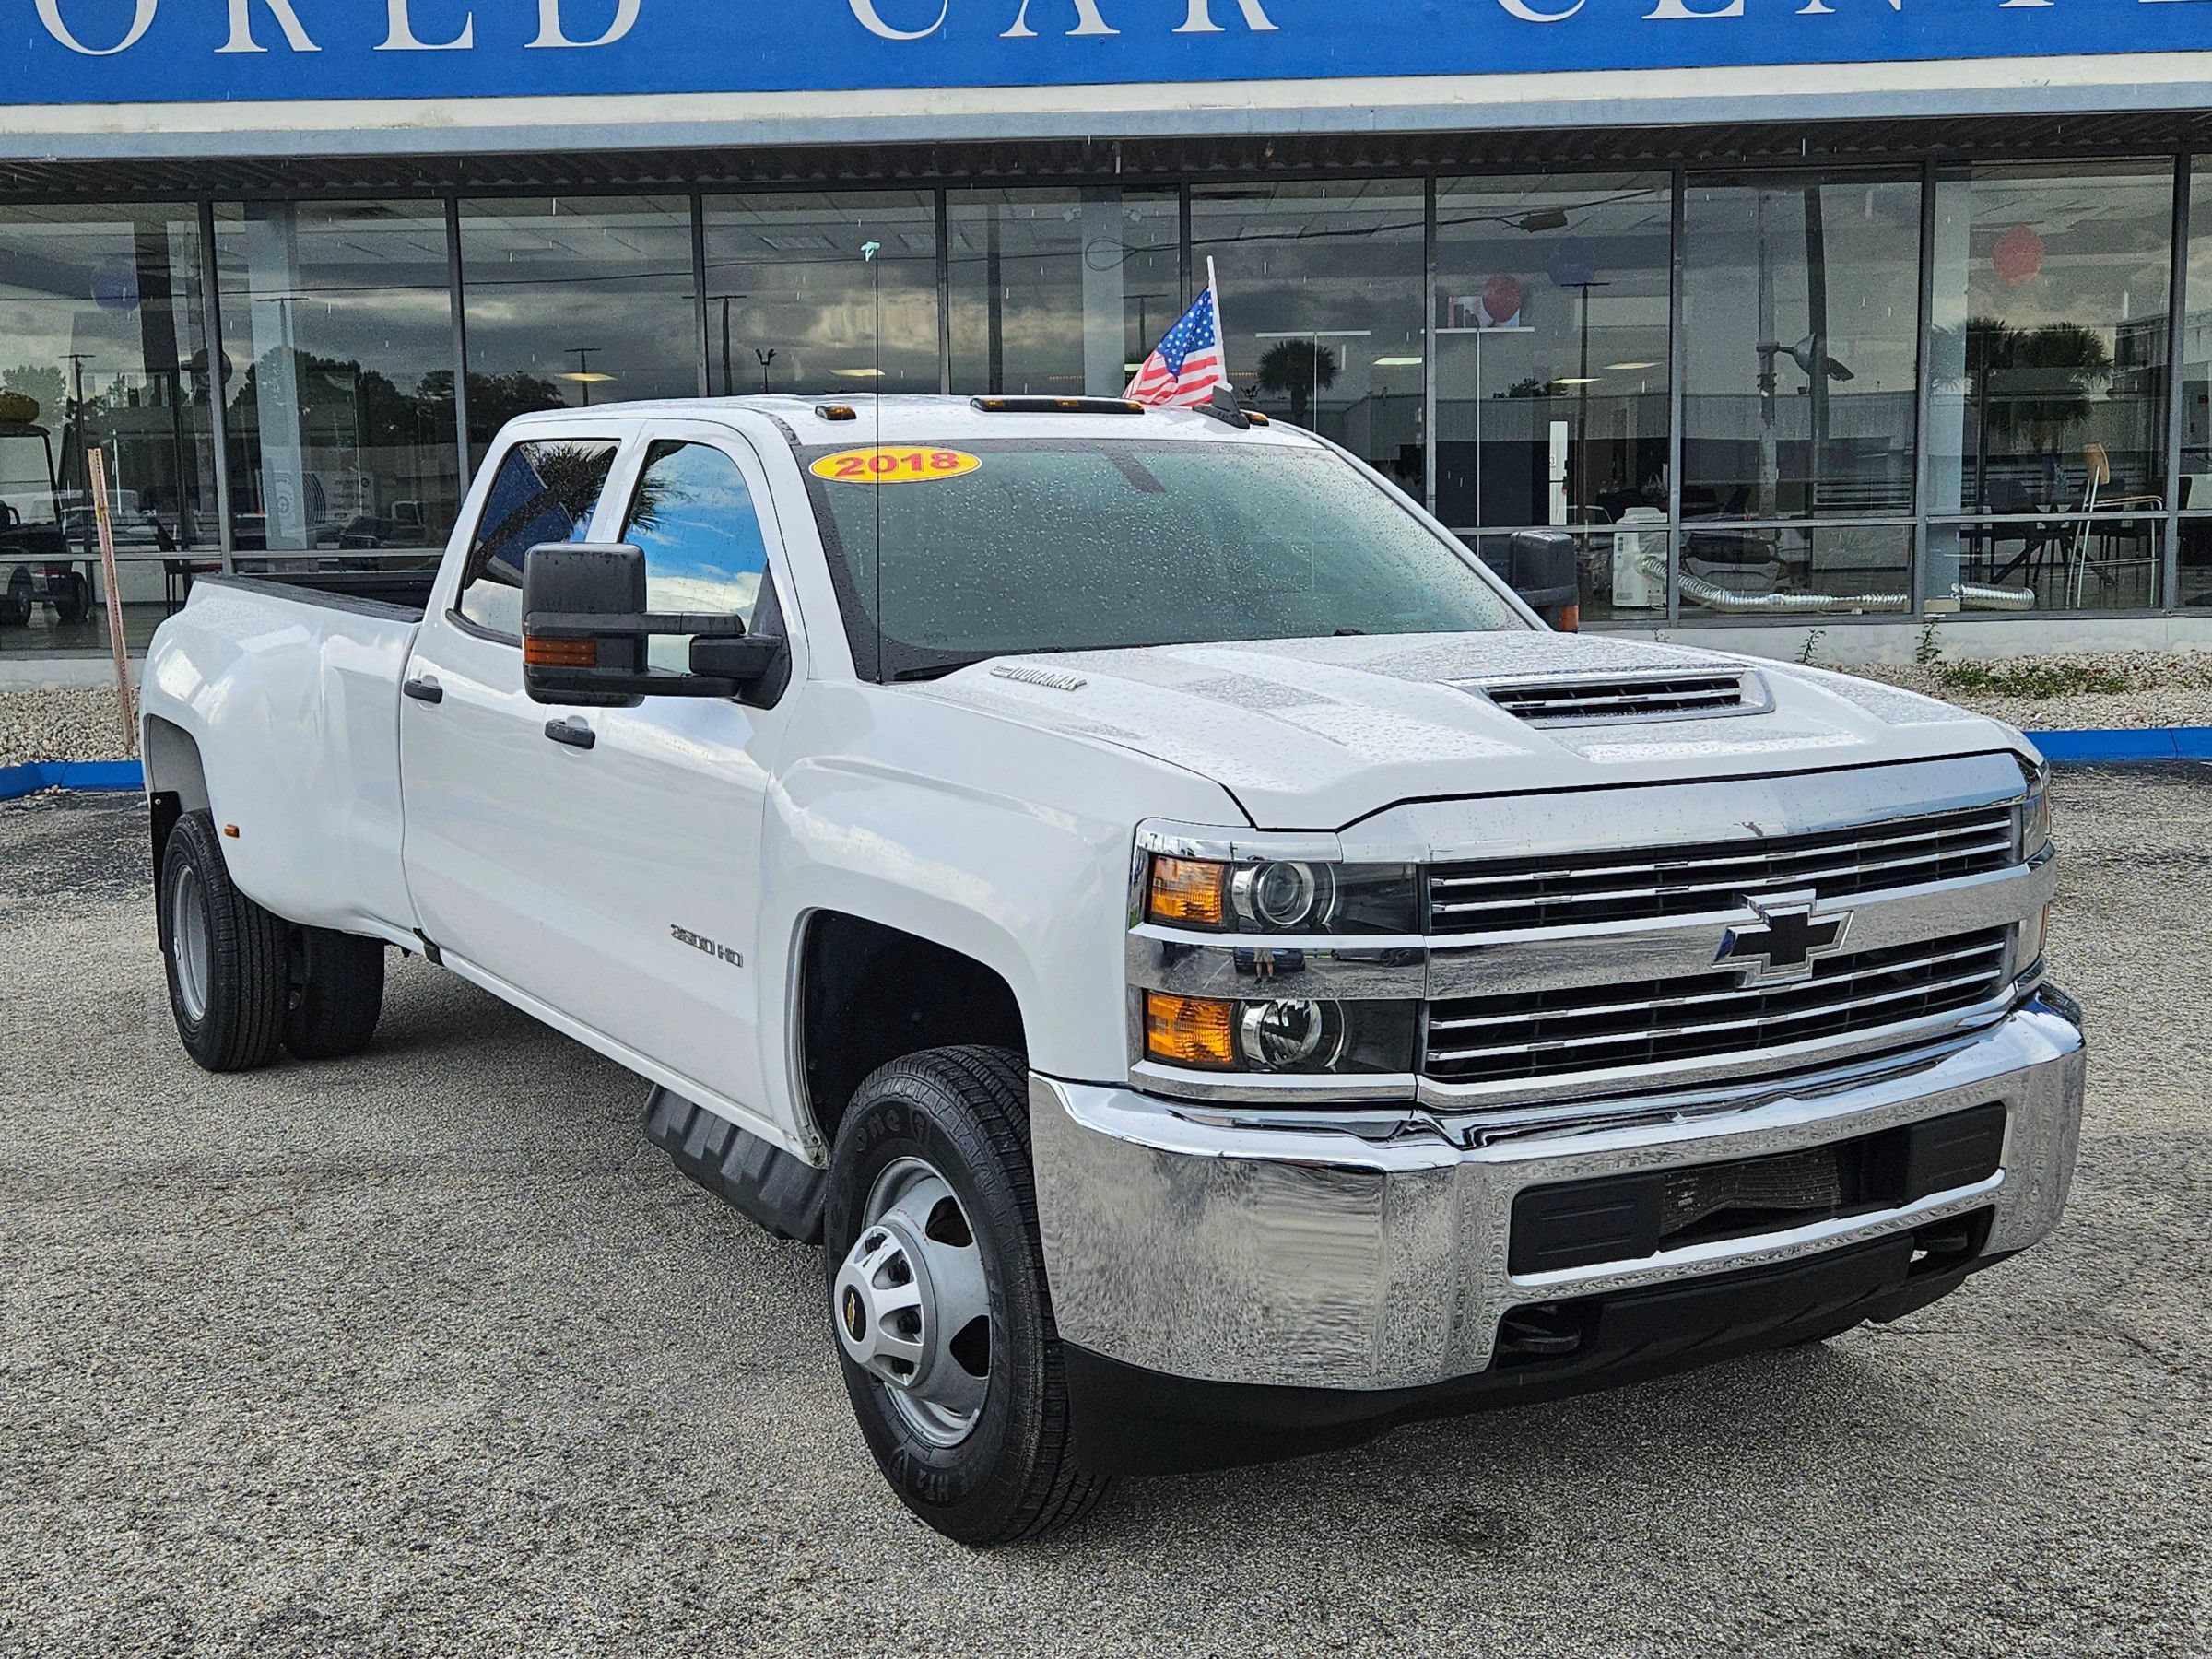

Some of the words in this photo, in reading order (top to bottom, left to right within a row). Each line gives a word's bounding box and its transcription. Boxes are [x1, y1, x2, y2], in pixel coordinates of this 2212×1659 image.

[835, 452, 959, 477] 2018
[670, 924, 715, 955] 3500
[717, 944, 743, 968] HD
